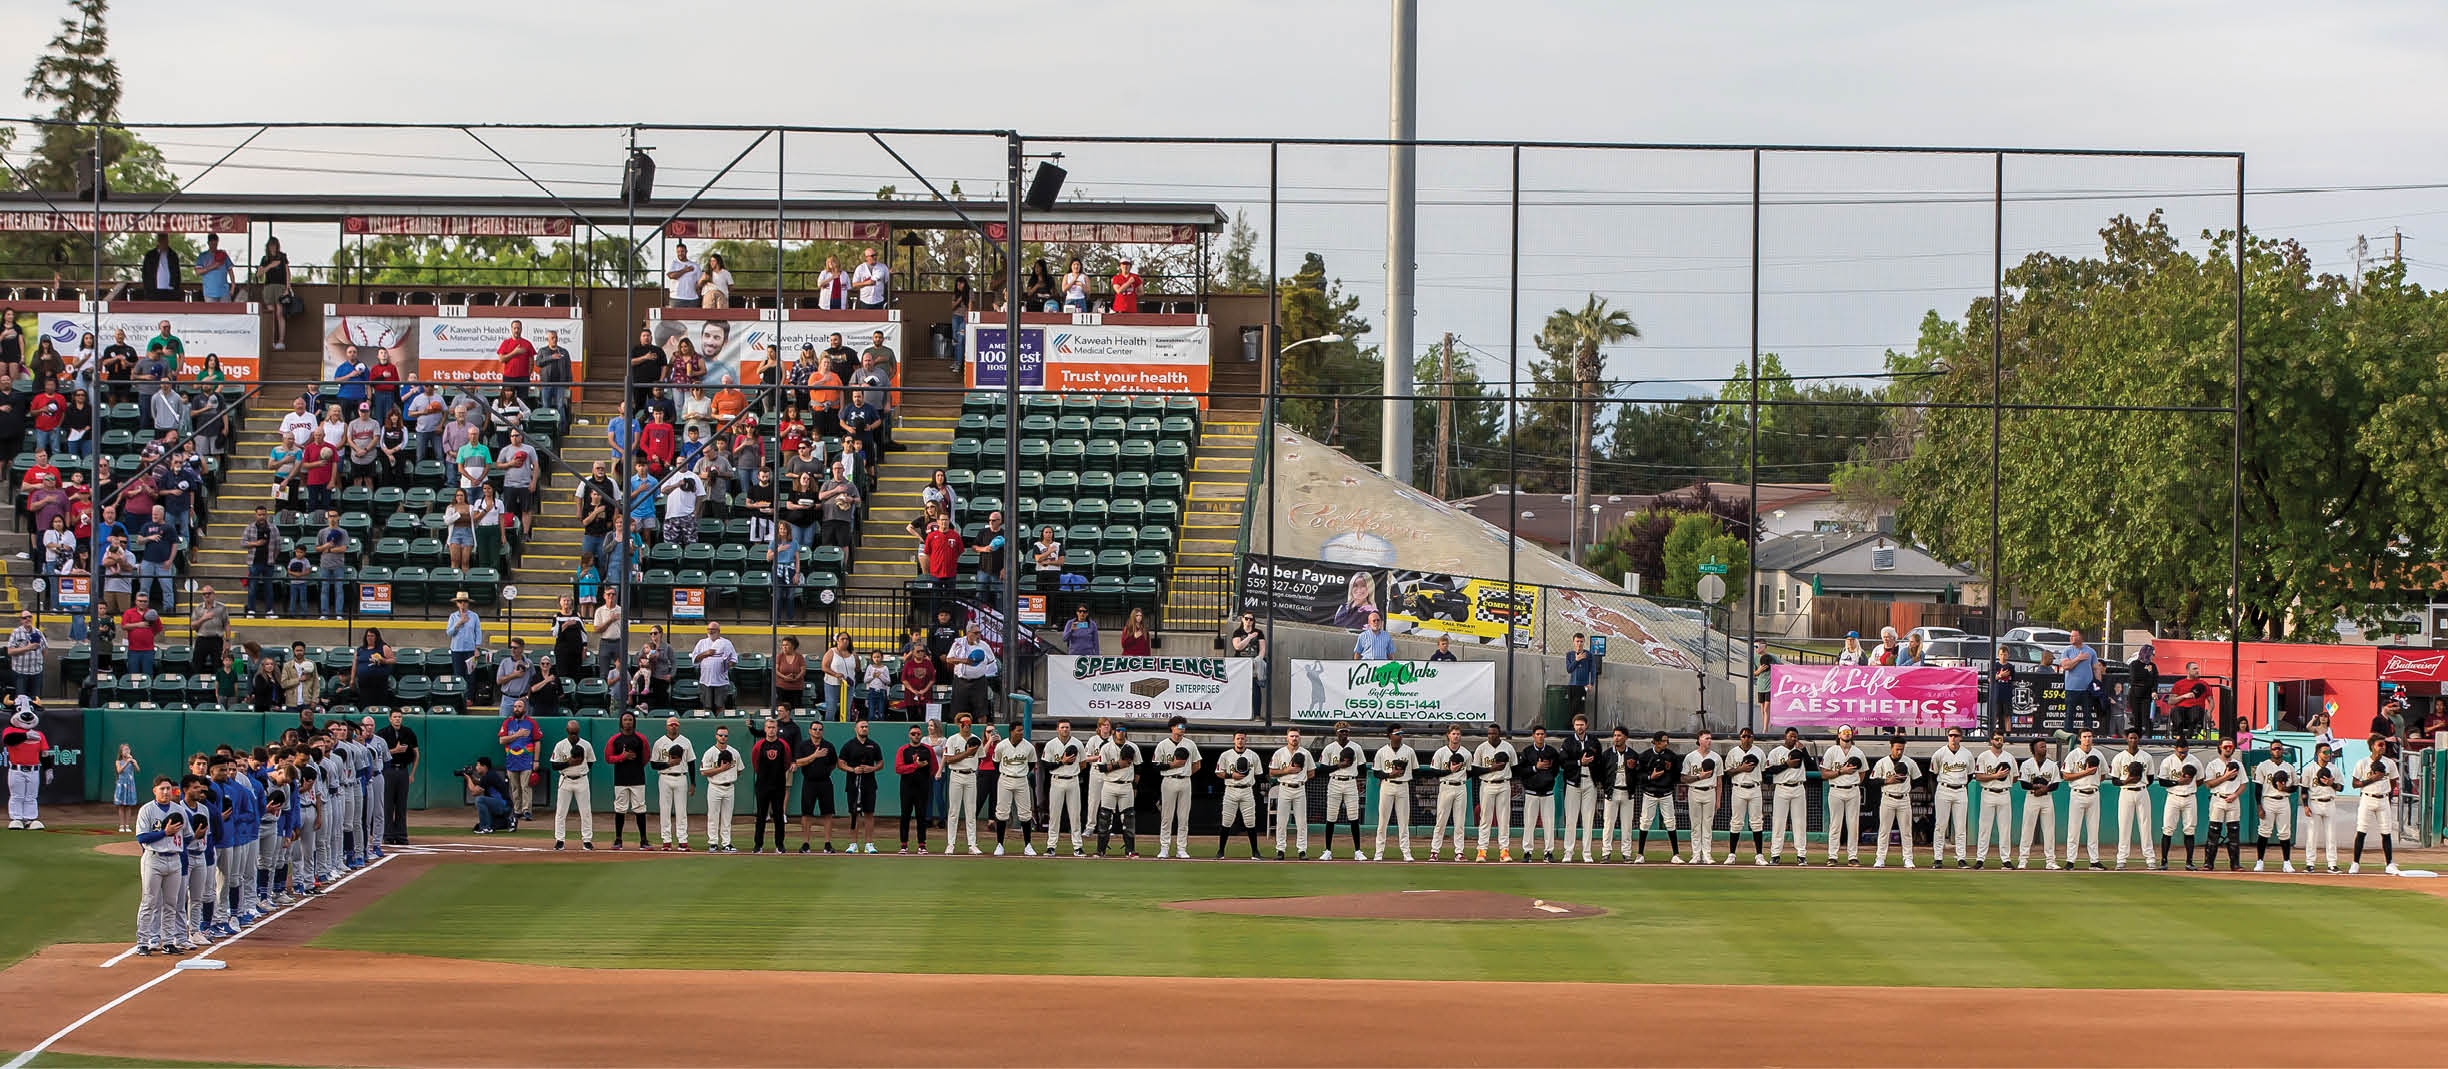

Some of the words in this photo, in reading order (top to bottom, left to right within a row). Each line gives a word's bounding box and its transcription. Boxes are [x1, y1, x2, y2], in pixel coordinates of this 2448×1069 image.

[63, 212, 102, 231] VALLE
[105, 212, 135, 231] OAKS
[138, 213, 166, 231] GOLF
[169, 213, 213, 232] COURSE
[368, 215, 400, 234] VISALIA
[403, 216, 443, 234] CHAMBER
[471, 216, 505, 235] FREITAS
[508, 217, 547, 235] ELECTRIC
[774, 220, 801, 239] VSALIA
[450, 326, 482, 334] Kaweah
[483, 325, 510, 335] Health
[805, 333, 832, 343] Healt
[1074, 335, 1113, 345] Kaweah
[1114, 336, 1148, 346] Health
[979, 351, 1006, 363] 100
[1019, 351, 1042, 363] est
[1074, 346, 1105, 355] Medical
[1106, 347, 1133, 356] Center
[433, 370, 450, 381] It's
[452, 370, 470, 381] the
[473, 370, 504, 381] botto
[1061, 370, 1101, 382] Trust
[1103, 372, 1138, 384] your
[1140, 371, 1189, 384] health
[289, 422, 312, 432] GIANTS
[1301, 568, 1345, 586] Payne
[1246, 577, 1319, 595] 559-327-6709
[1278, 602, 1313, 612] MORTGAGE
[1074, 656, 1155, 680] SPENCE
[1158, 657, 1228, 683] FENCE
[2389, 659, 2439, 670] Budweiser
[1348, 662, 1393, 691] Valley
[1397, 661, 1439, 685] Oaks
[1773, 665, 1842, 699] Lush
[1841, 667, 1900, 696] Life
[1092, 682, 1124, 692] COMPANY
[1175, 684, 1220, 694] ENTERPRISES
[1367, 687, 1389, 699] Golf
[1088, 699, 1151, 710] 651-2889
[1163, 701, 1212, 711] VISALIA
[1344, 698, 1383, 710] (559)
[1385, 699, 1441, 710] 651-1441
[1786, 698, 1958, 715] AESTHETICS
